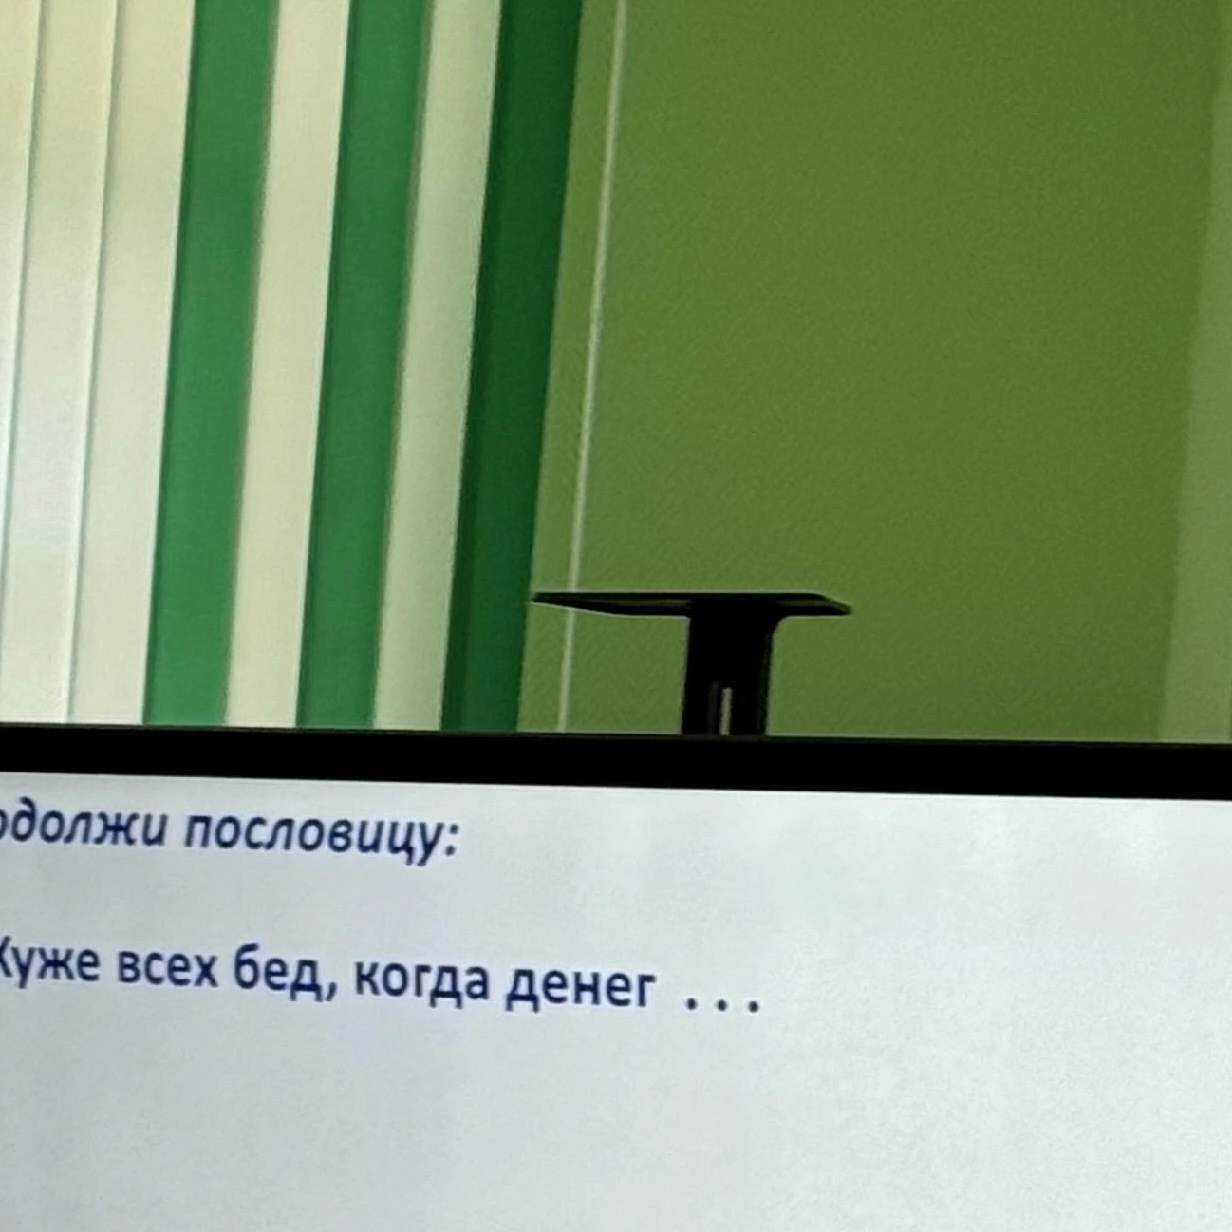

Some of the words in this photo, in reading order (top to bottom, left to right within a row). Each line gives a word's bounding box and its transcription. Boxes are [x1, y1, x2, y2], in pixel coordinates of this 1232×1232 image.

[183, 812, 460, 867] пословицу:
[118, 949, 219, 989] всех
[234, 942, 338, 1002] бед,
[355, 959, 490, 1010] когда
[504, 967, 657, 1014] денег
